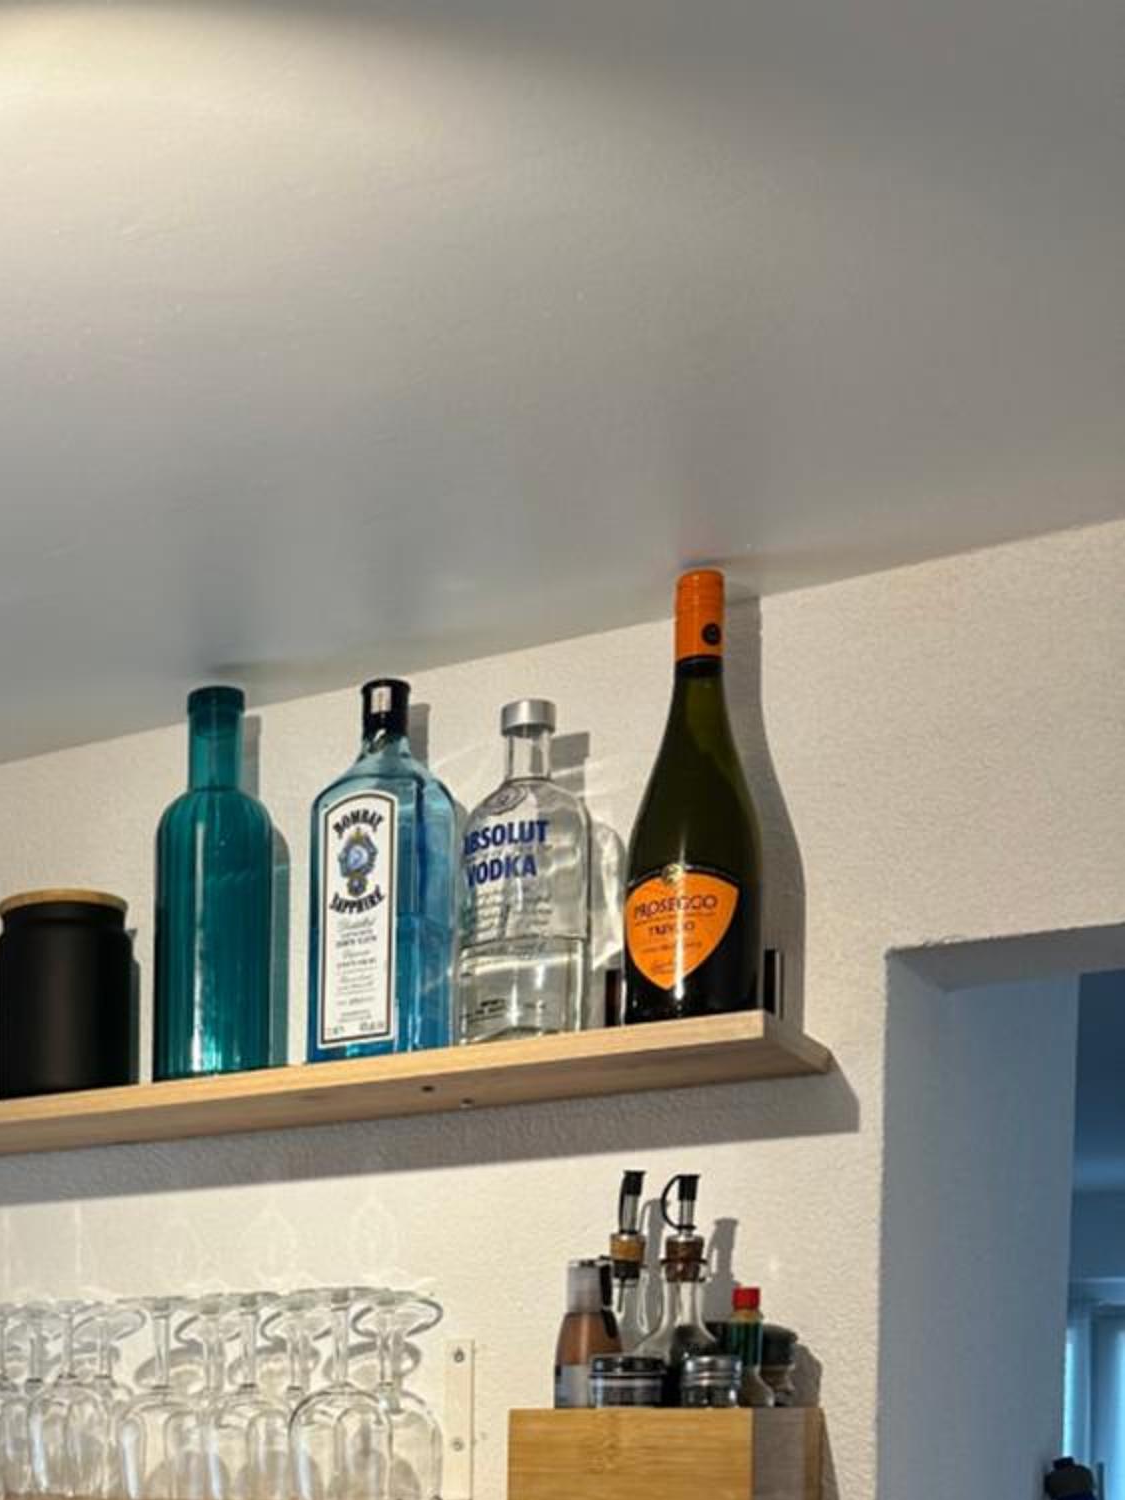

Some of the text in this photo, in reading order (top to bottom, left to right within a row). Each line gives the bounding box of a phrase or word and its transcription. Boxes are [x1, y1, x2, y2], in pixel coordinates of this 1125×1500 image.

[333, 808, 384, 838] BOMBAY
[463, 819, 550, 855] ABSOLUT
[466, 854, 537, 887] VODKA
[329, 884, 385, 914] SAPPHIRE
